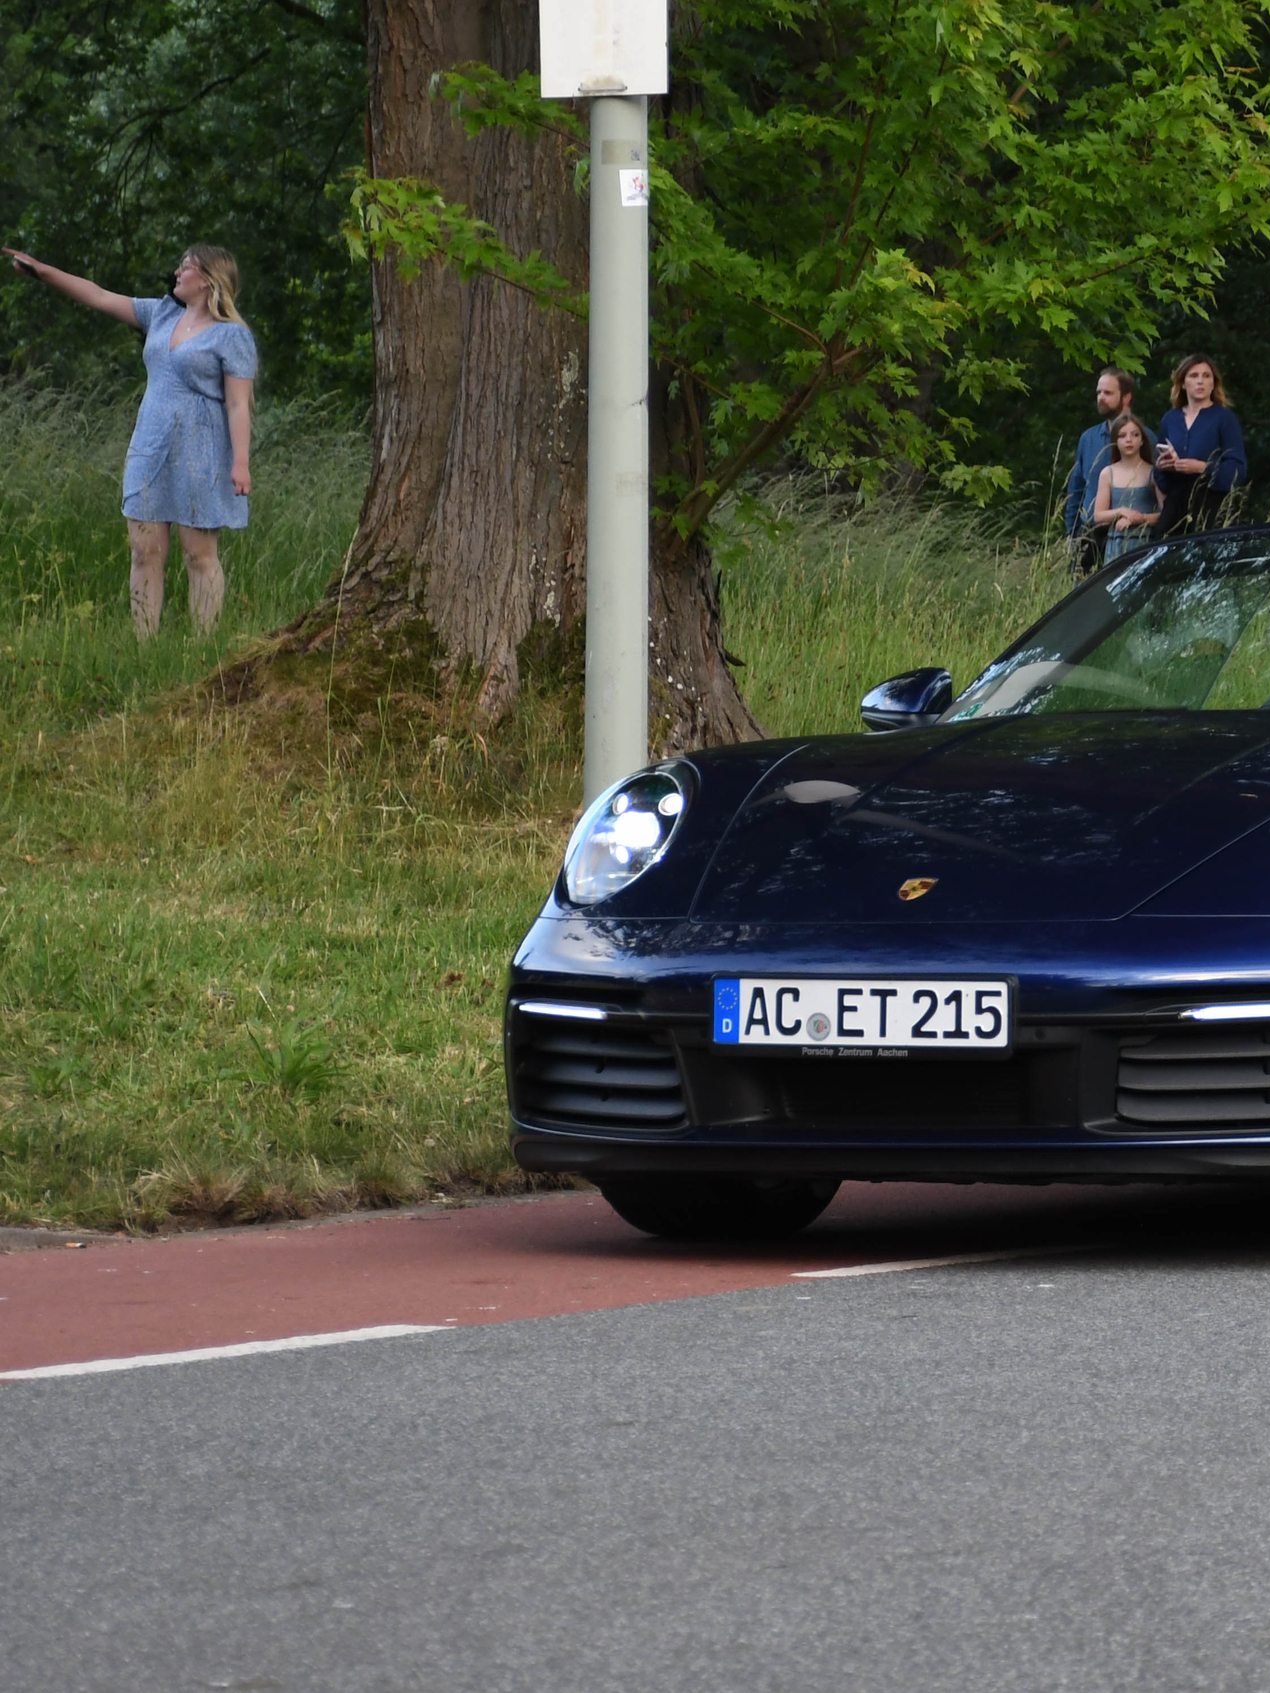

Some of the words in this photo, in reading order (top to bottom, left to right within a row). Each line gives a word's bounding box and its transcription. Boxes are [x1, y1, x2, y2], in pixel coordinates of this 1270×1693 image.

[744, 986, 802, 1036] AC
[837, 988, 898, 1038] ET
[911, 989, 1002, 1040] 215
[722, 1018, 732, 1033] D
[802, 1047, 834, 1056] Porsche
[838, 1047, 873, 1057] Zentrum
[877, 1048, 908, 1057] Aachen
